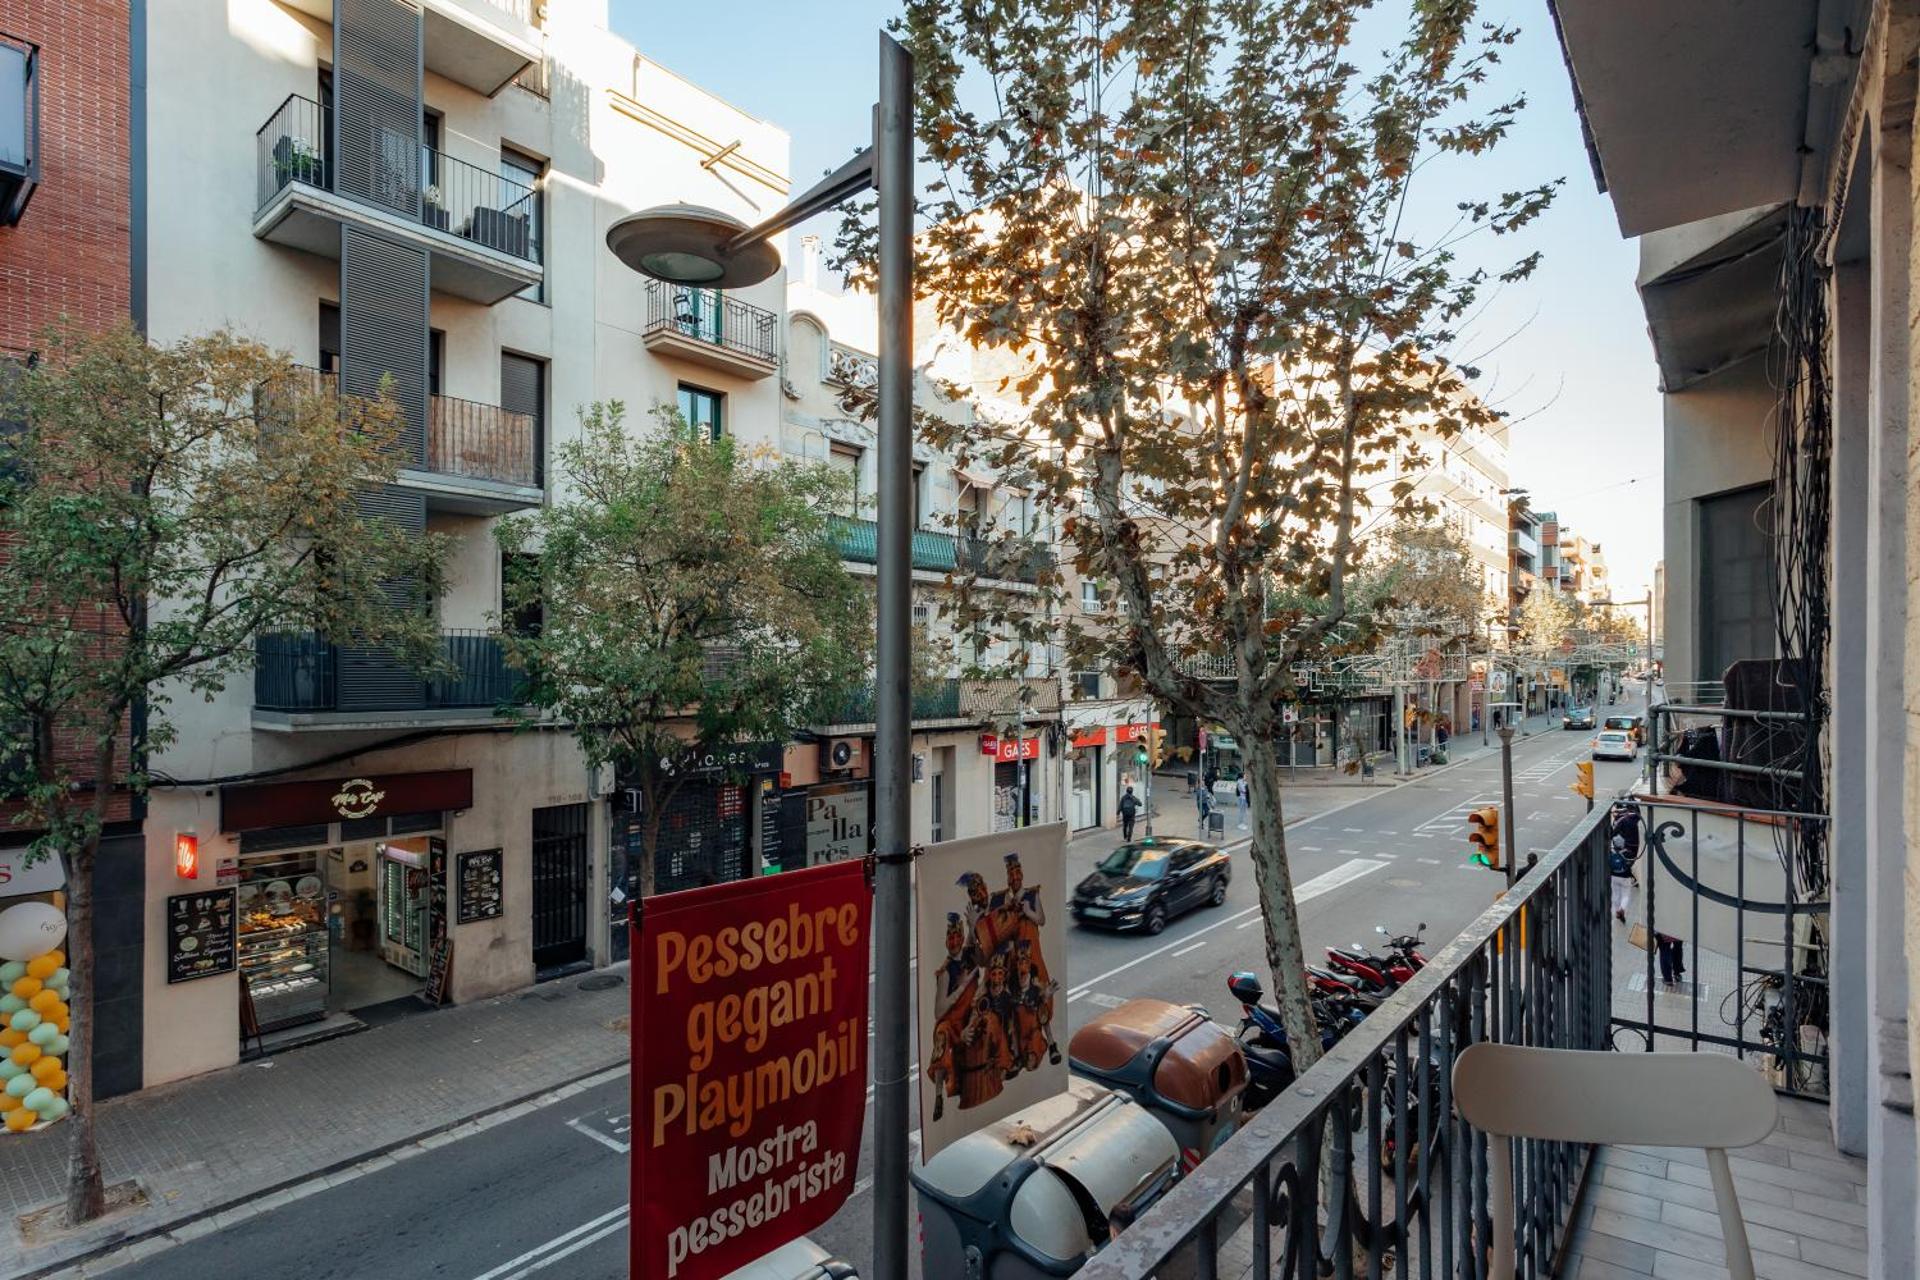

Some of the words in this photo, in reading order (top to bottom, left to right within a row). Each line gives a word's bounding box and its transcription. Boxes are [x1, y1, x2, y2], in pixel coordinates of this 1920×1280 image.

[1004, 742, 1031, 758] GAES
[807, 798, 839, 822] Pa
[831, 816, 863, 842] lla
[656, 903, 859, 995] Pessebre
[687, 955, 837, 1072] gegant
[652, 1017, 858, 1148] Playmobil
[707, 1119, 818, 1196] Mostra
[668, 1150, 846, 1279] pessebrista
